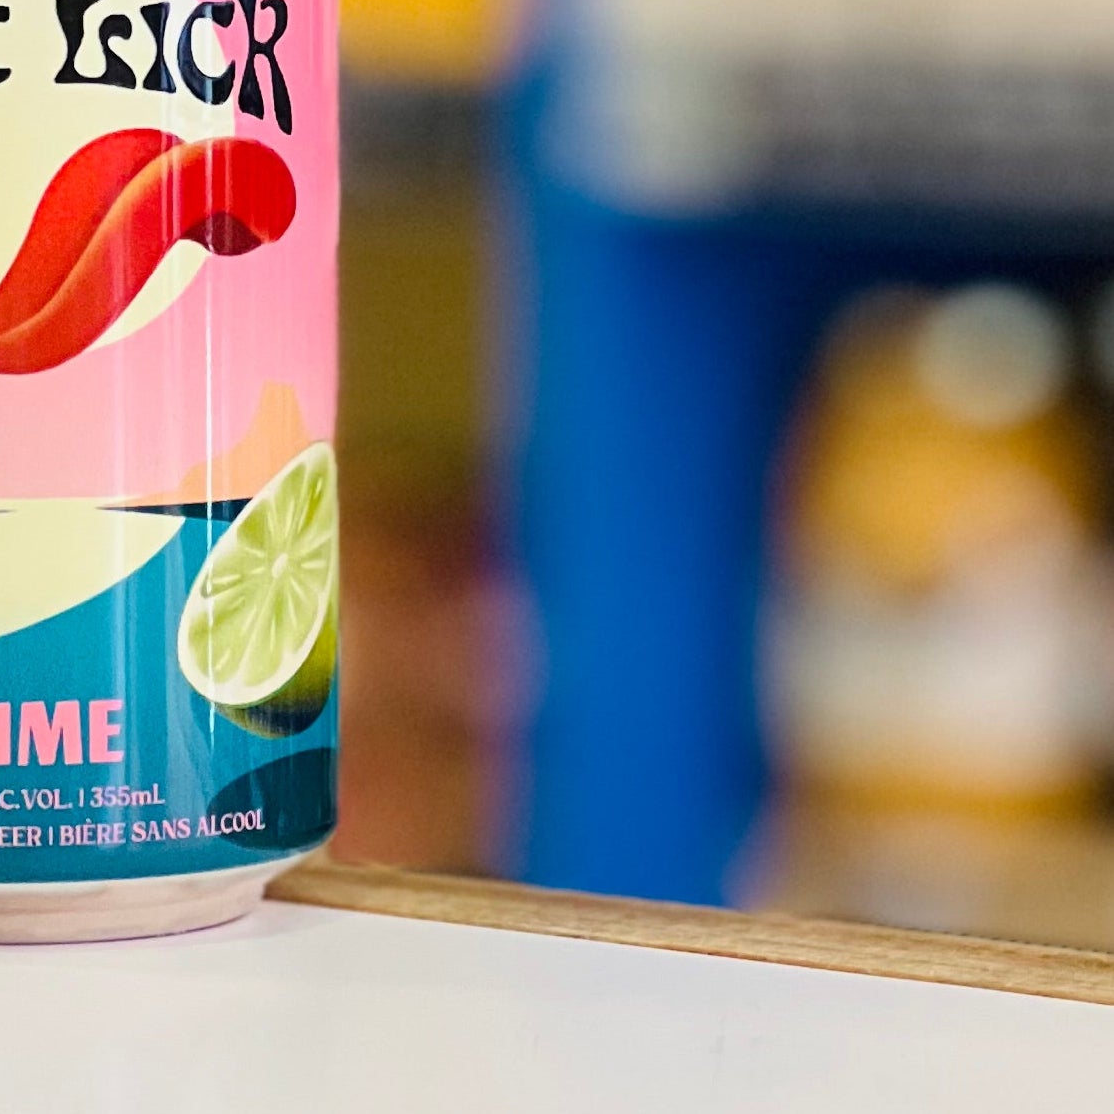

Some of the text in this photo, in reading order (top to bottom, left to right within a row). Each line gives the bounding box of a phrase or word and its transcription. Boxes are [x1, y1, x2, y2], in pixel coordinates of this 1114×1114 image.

[89, 782, 166, 809] 355mL
[59, 817, 127, 847] BIÈRE
[131, 818, 192, 843] SANS
[196, 807, 266, 838] ALCOOL
